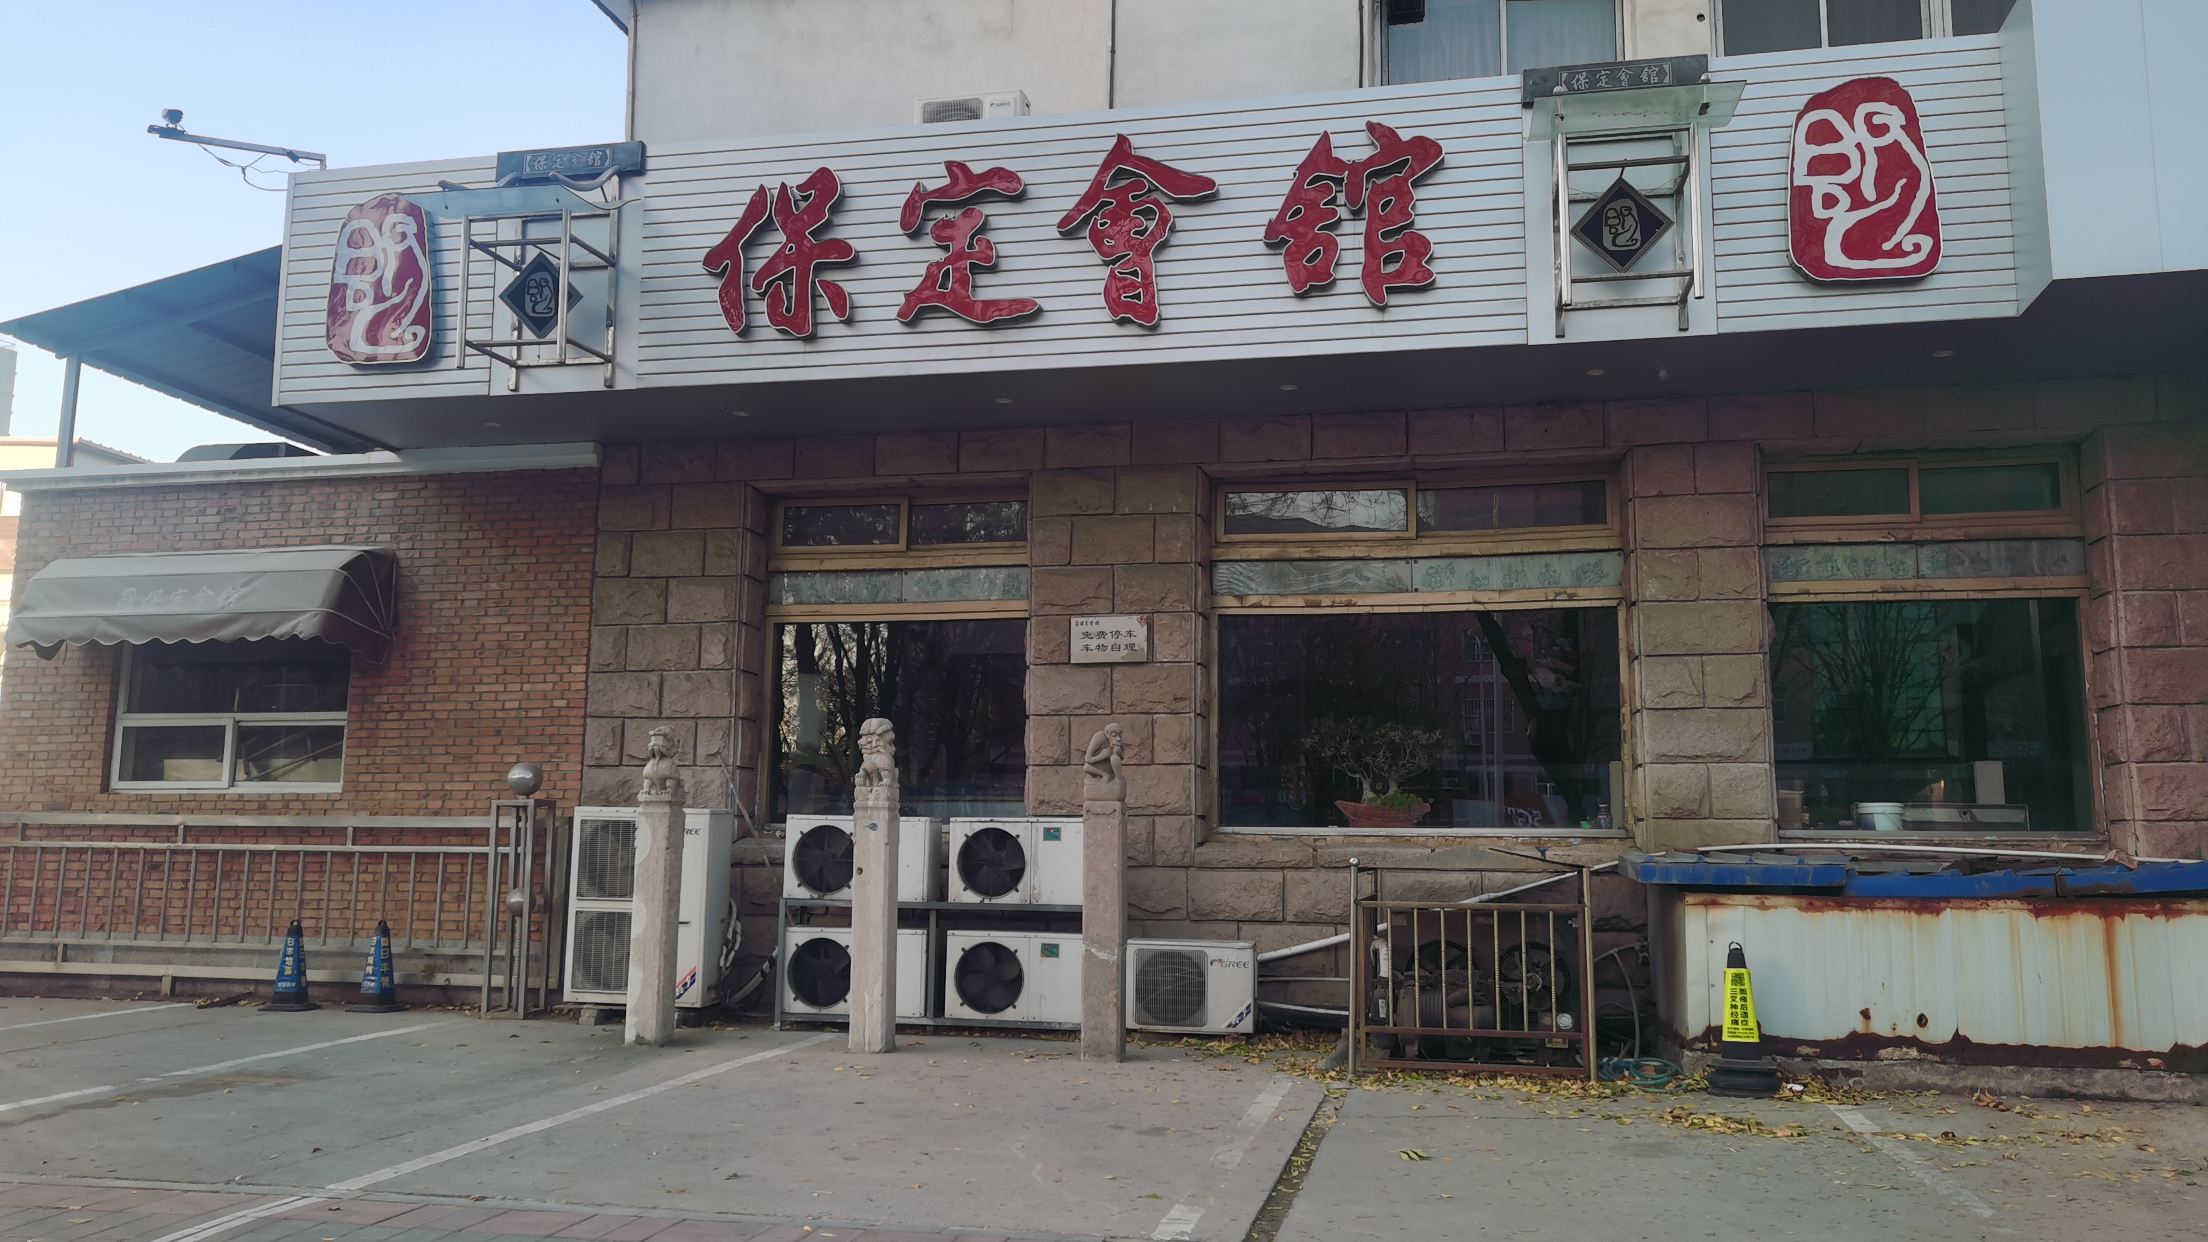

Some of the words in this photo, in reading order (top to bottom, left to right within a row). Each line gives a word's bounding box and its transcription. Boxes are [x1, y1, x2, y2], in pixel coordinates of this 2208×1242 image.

[1080, 630, 1137, 640] 免费停车
[1080, 643, 1137, 652] 车物自理
[1220, 960, 1249, 968] GREE
[1729, 988, 1739, 1026] 三叉神经痛
